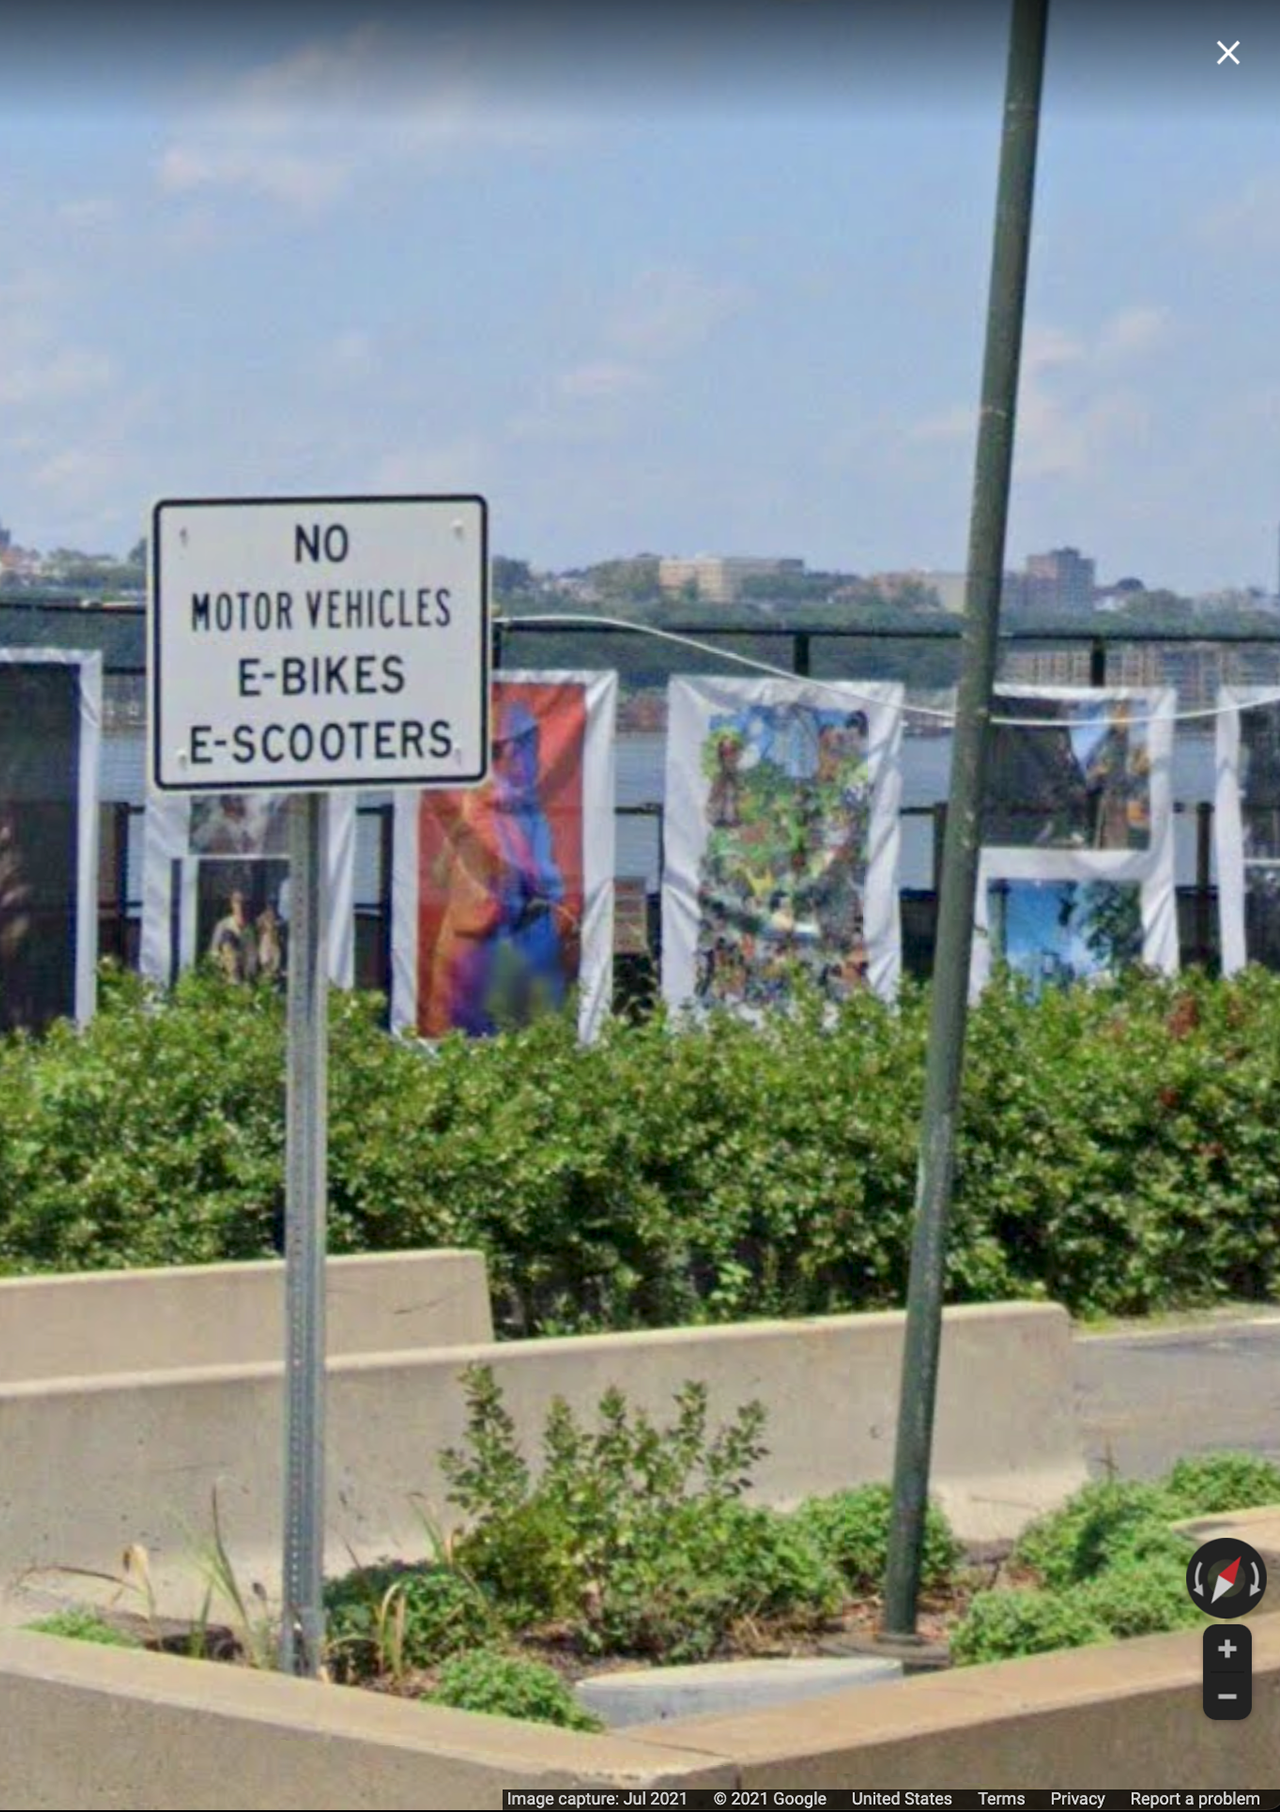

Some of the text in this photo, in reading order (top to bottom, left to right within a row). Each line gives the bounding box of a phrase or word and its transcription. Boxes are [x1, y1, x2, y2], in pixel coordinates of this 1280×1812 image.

[294, 524, 350, 563] NO
[191, 588, 452, 632] MOTOR VEHICLES
[239, 655, 406, 697] E-BIKES
[190, 720, 453, 764] E-SCOOTERS
